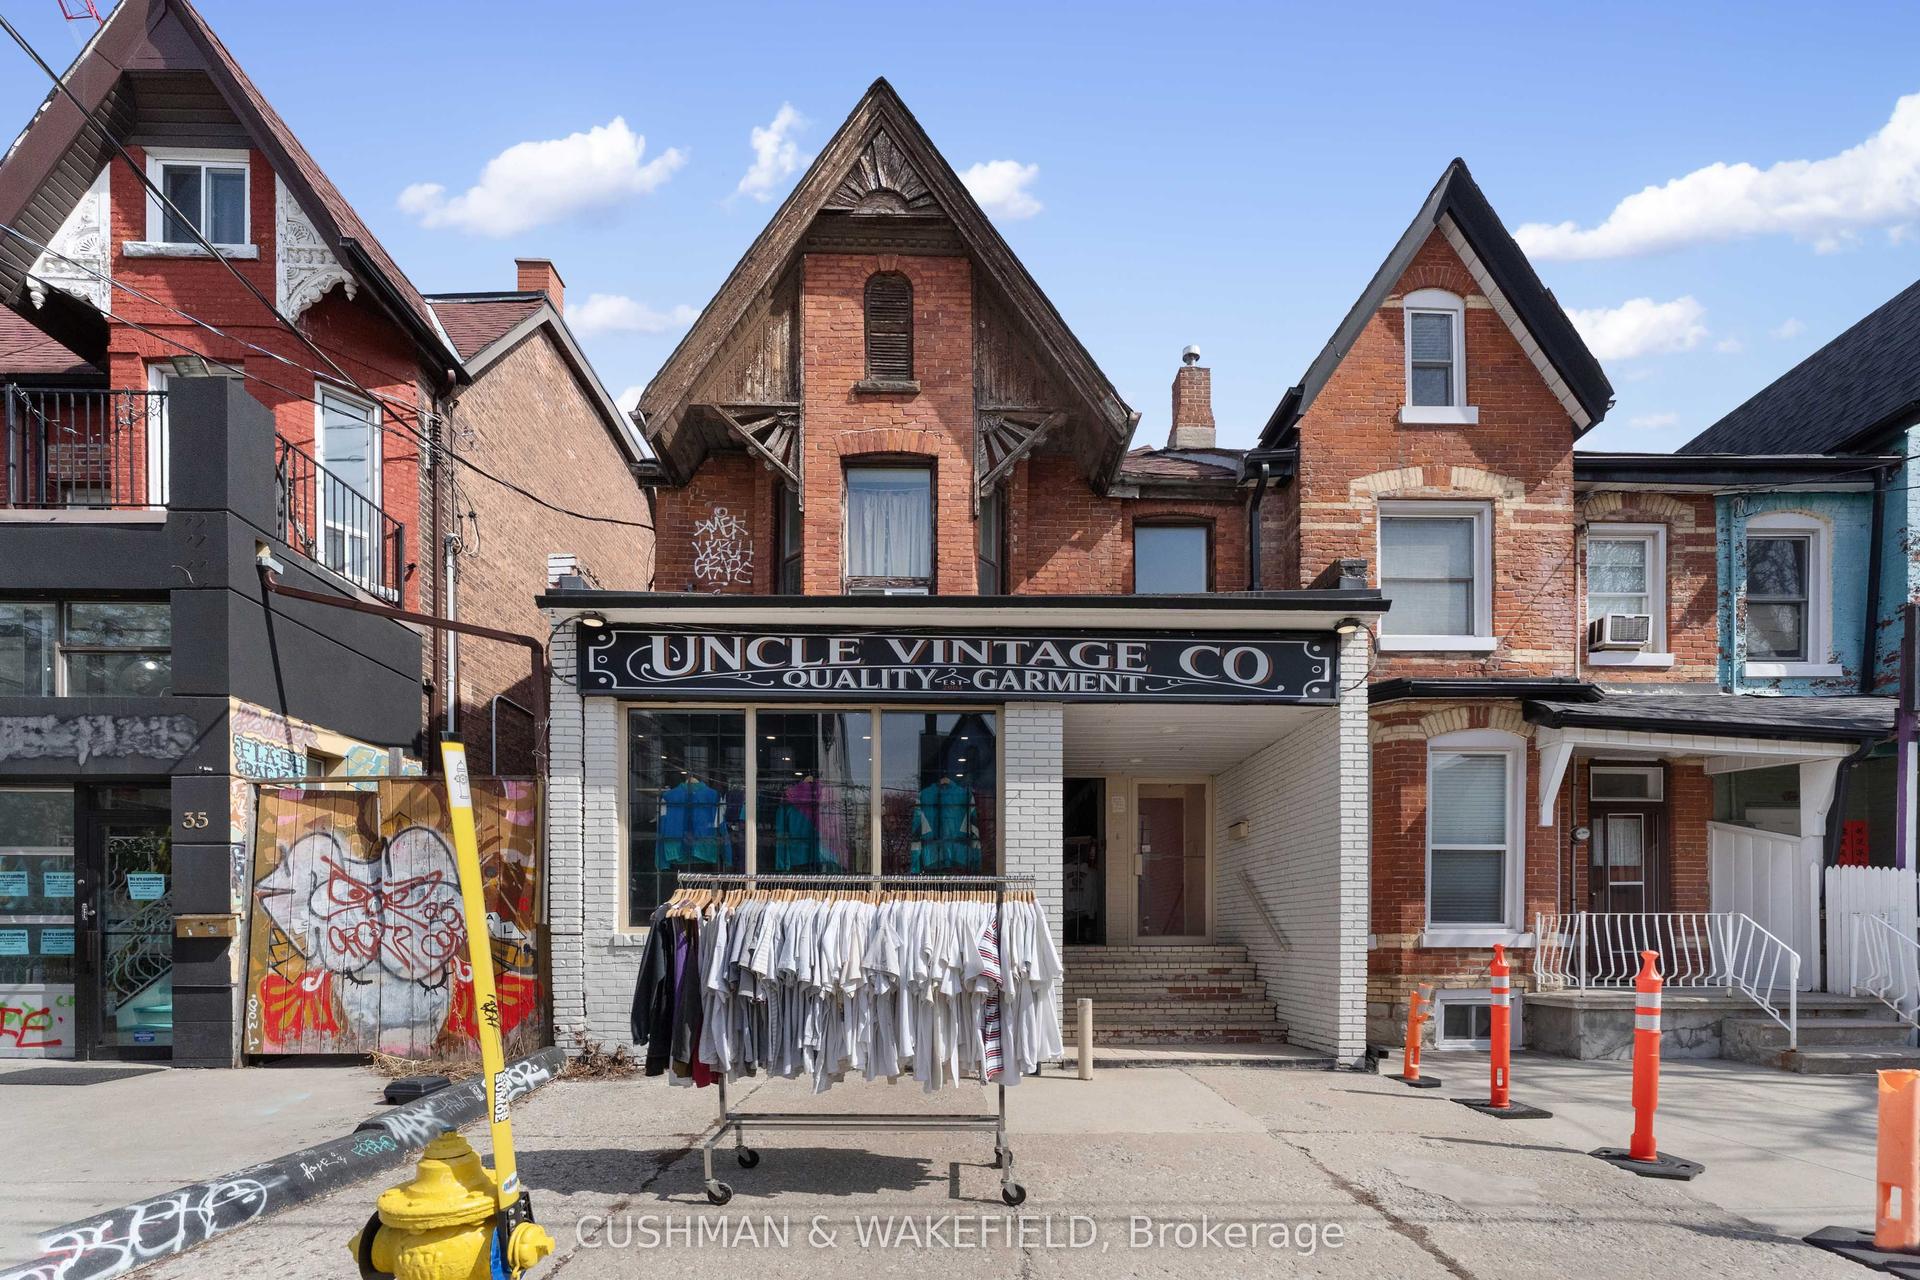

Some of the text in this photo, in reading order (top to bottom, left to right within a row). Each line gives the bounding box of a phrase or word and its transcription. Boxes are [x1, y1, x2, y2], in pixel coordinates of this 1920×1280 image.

[649, 635, 1274, 686] UNCLE VINTAGE CO
[783, 668, 1146, 692] QUALITY GARMENT
[182, 811, 209, 830] 35
